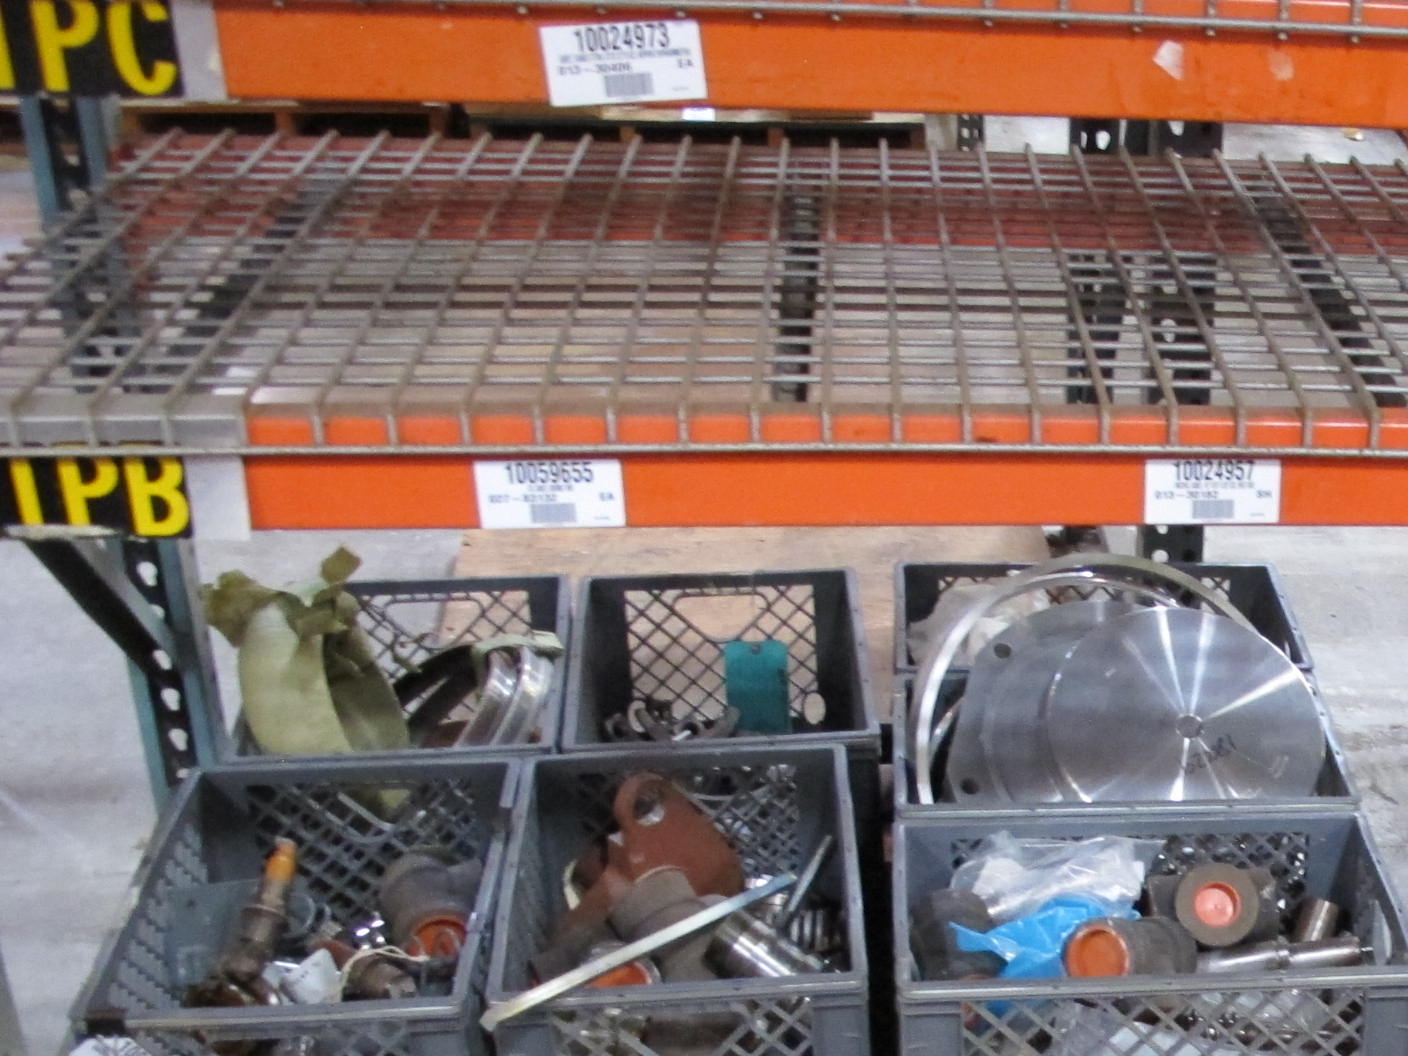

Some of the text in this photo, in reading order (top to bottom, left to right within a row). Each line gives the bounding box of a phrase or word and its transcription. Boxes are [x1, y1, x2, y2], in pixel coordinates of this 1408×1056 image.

[573, 22, 670, 51] 10024973
[505, 461, 594, 484] 10059655
[1173, 460, 1255, 480] 10024957
